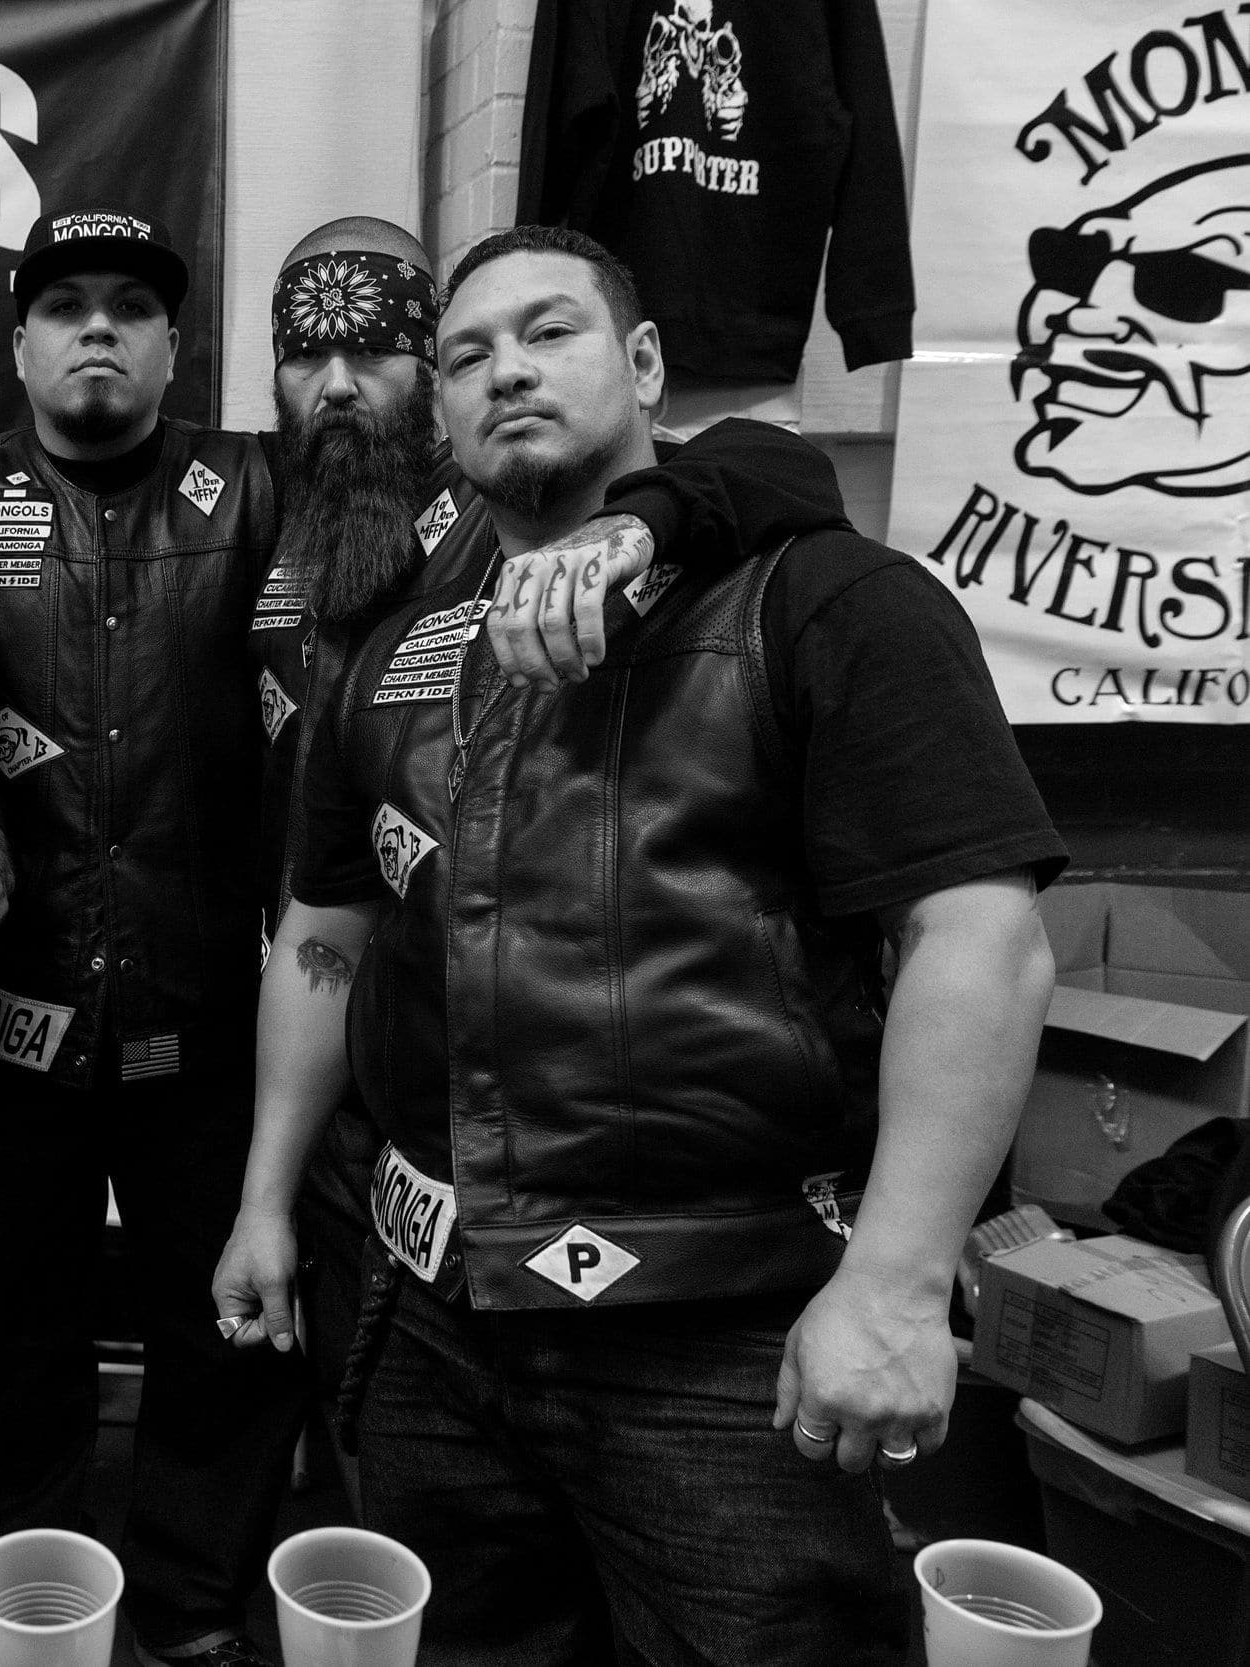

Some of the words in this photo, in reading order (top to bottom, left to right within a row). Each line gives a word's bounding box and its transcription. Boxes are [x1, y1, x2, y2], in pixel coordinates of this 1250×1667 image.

[74, 213, 128, 225] CALIFORNIA
[188, 487, 218, 502] MFFM
[420, 521, 449, 540] MFFM
[10, 559, 41, 569] MEMBER
[411, 603, 486, 634] MONGOLS
[384, 672, 423, 684] CHARTER
[425, 668, 457, 680] MEMBE
[376, 689, 416, 701] RFKN
[567, 1243, 601, 1283] P
